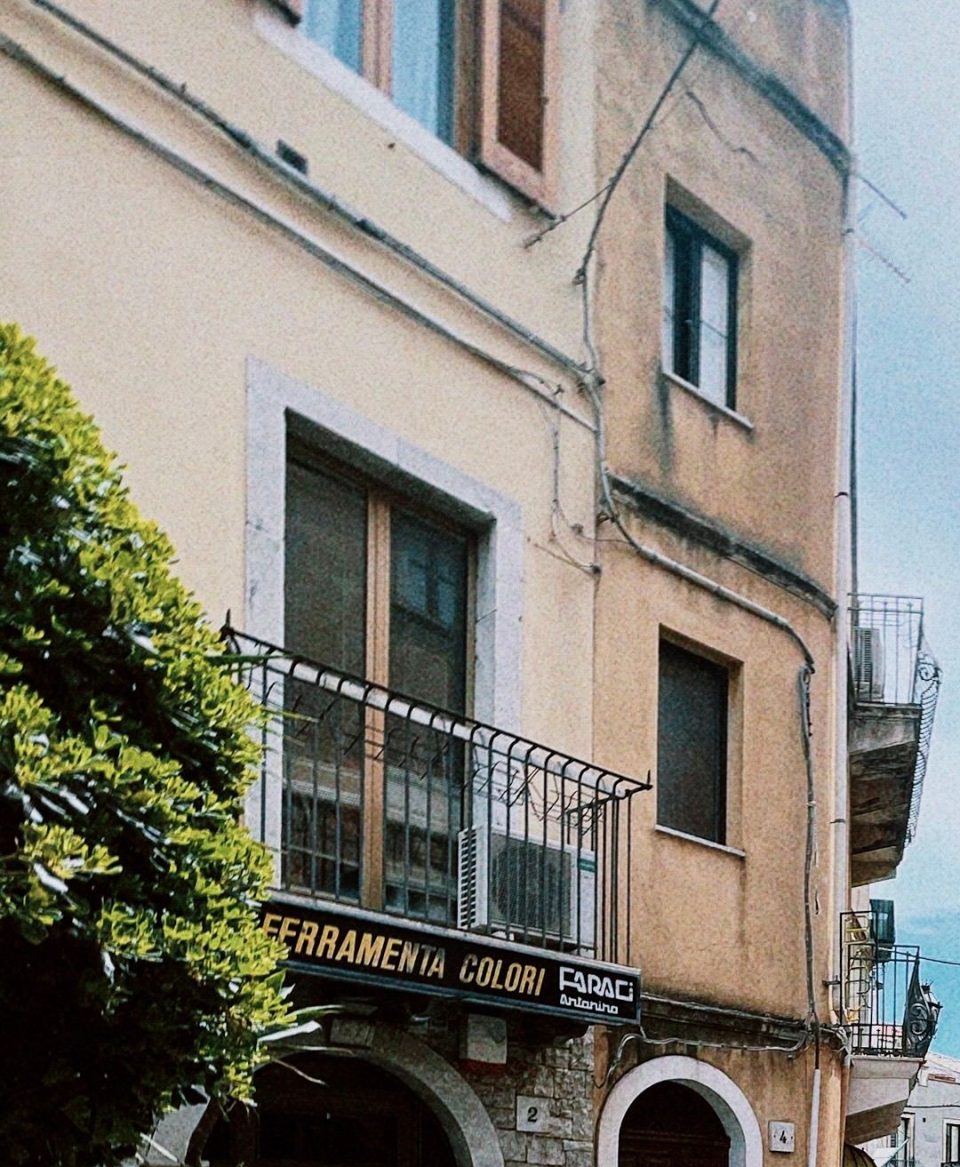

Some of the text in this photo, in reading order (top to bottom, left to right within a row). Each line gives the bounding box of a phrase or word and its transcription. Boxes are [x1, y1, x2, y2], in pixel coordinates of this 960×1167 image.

[263, 913, 546, 997] FERRAMENTA COLORI
[527, 1106, 539, 1123] 2
[779, 1129, 787, 1144] 4
